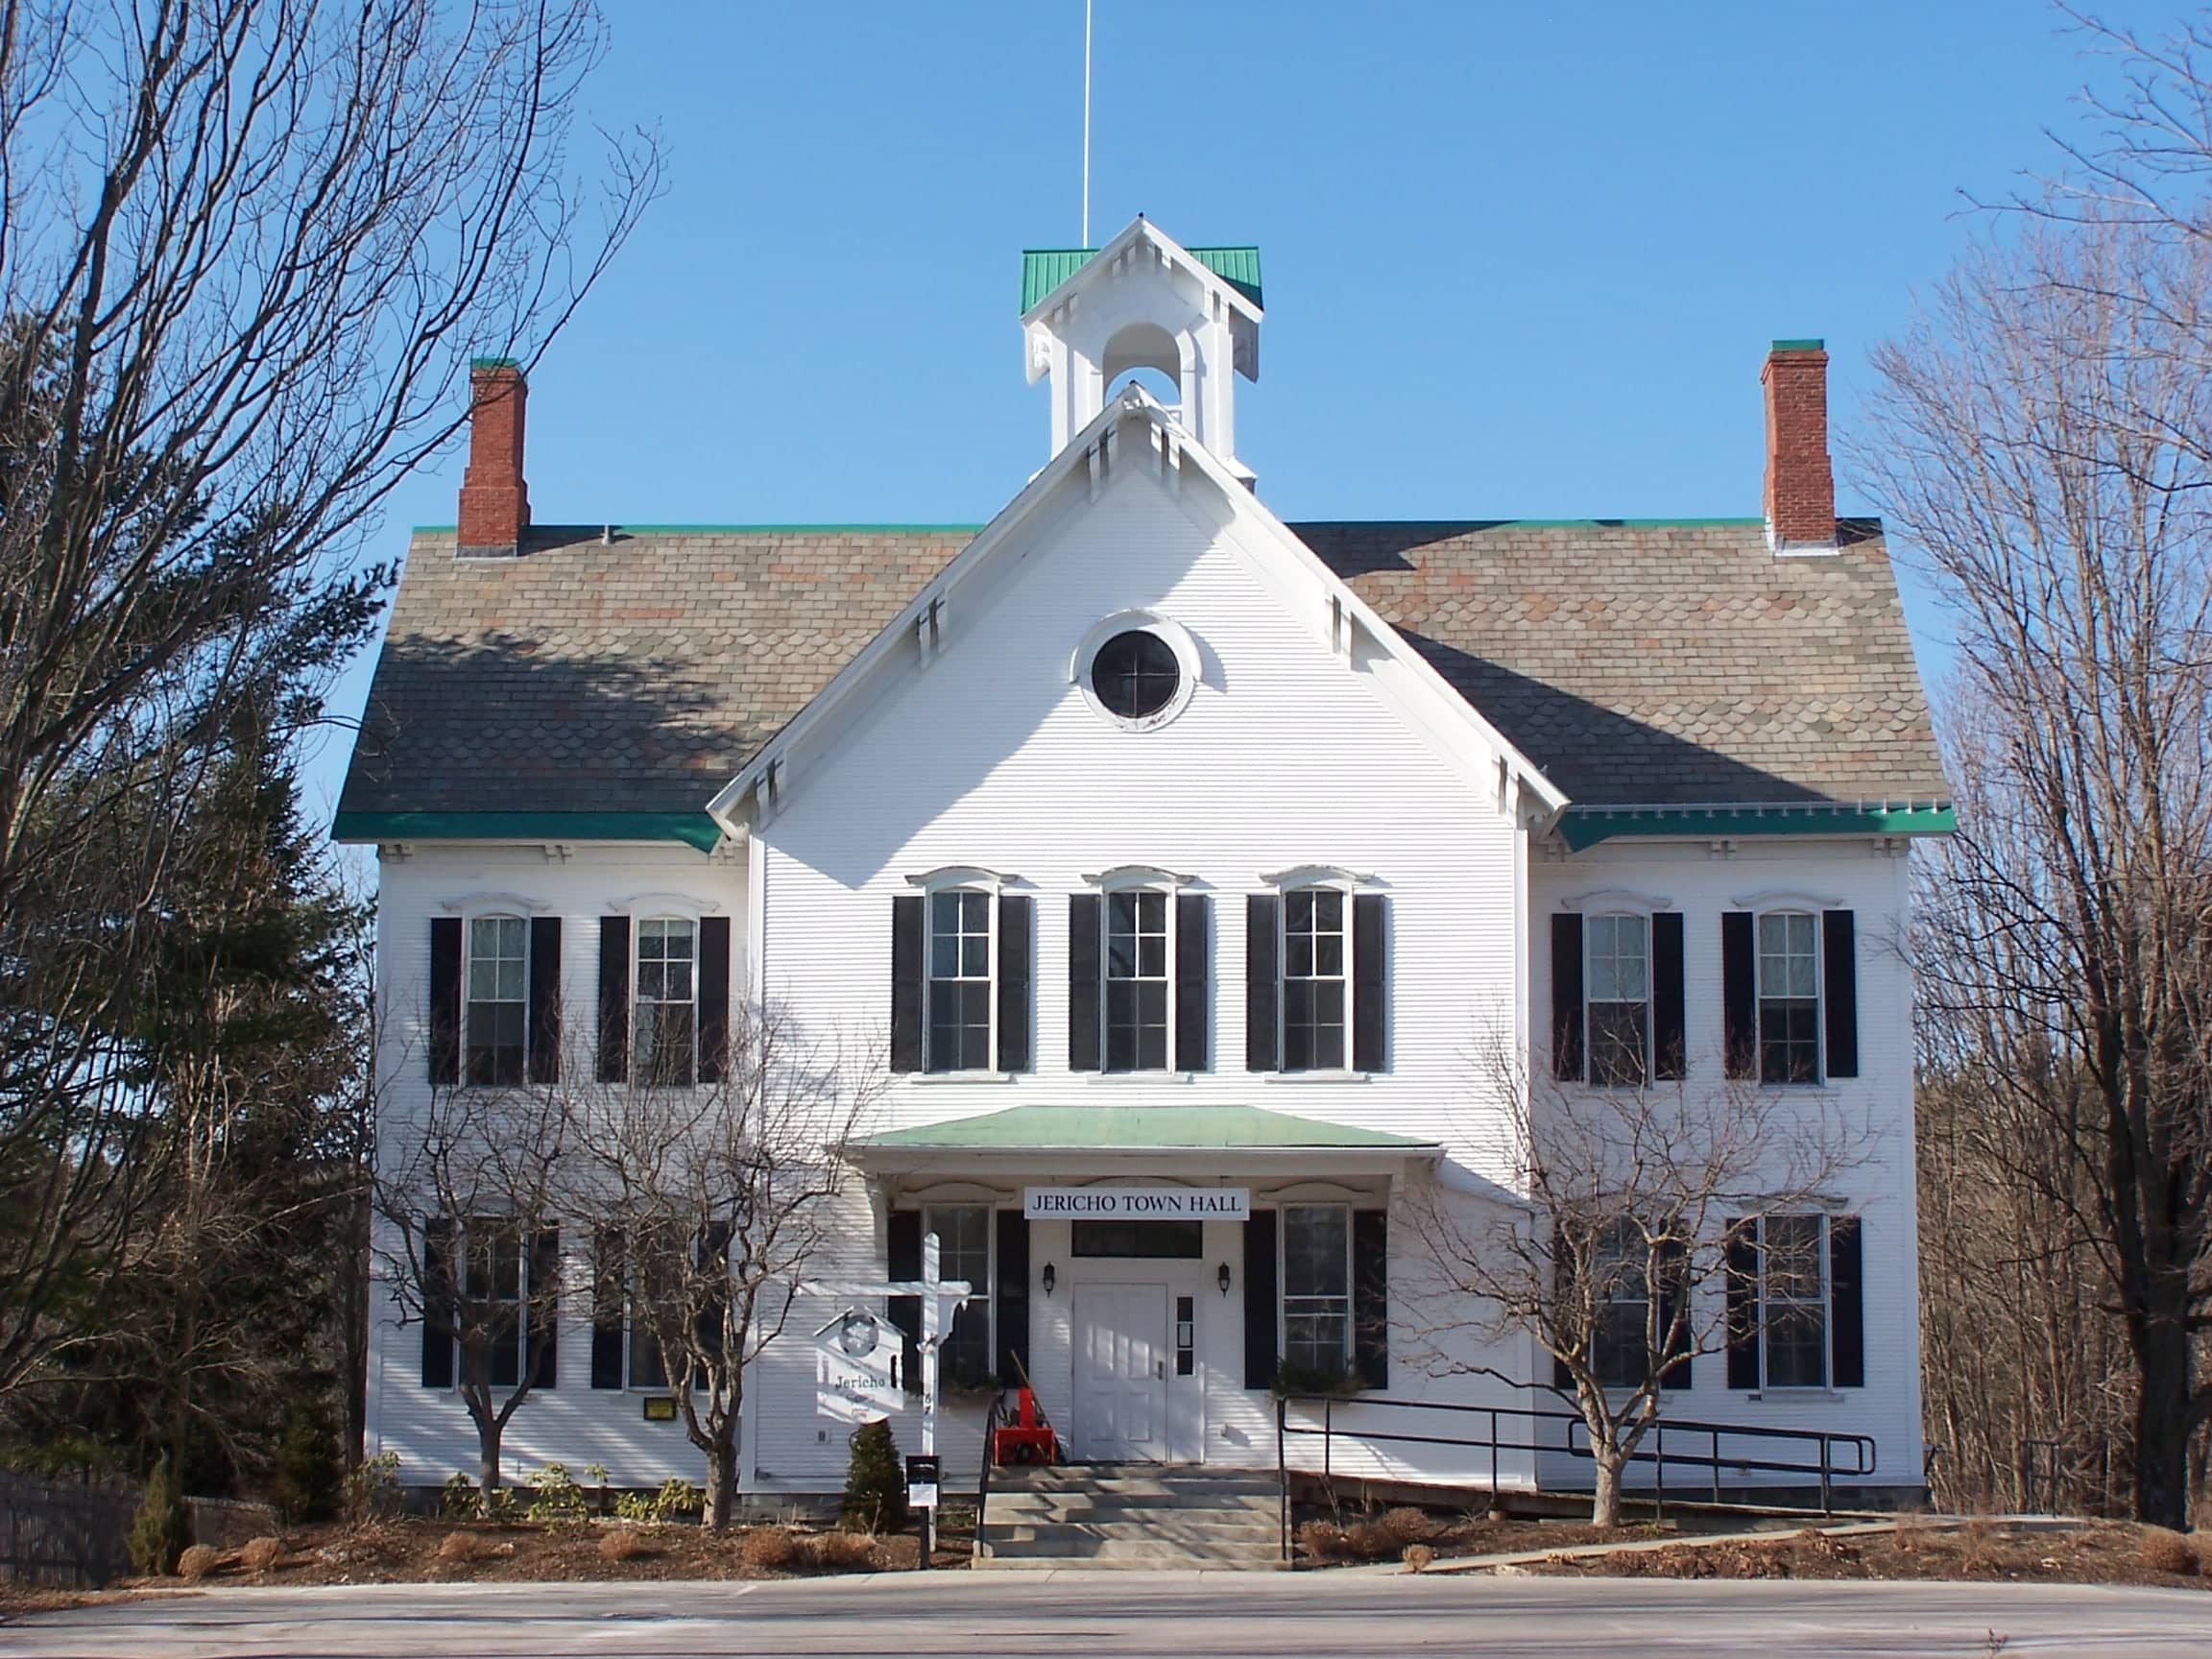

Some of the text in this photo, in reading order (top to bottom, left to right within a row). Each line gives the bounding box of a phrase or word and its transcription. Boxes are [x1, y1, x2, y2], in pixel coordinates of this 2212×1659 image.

[1032, 1195, 1241, 1212] JERICHO TOWN HALL
[835, 1375, 885, 1389] Jericho
